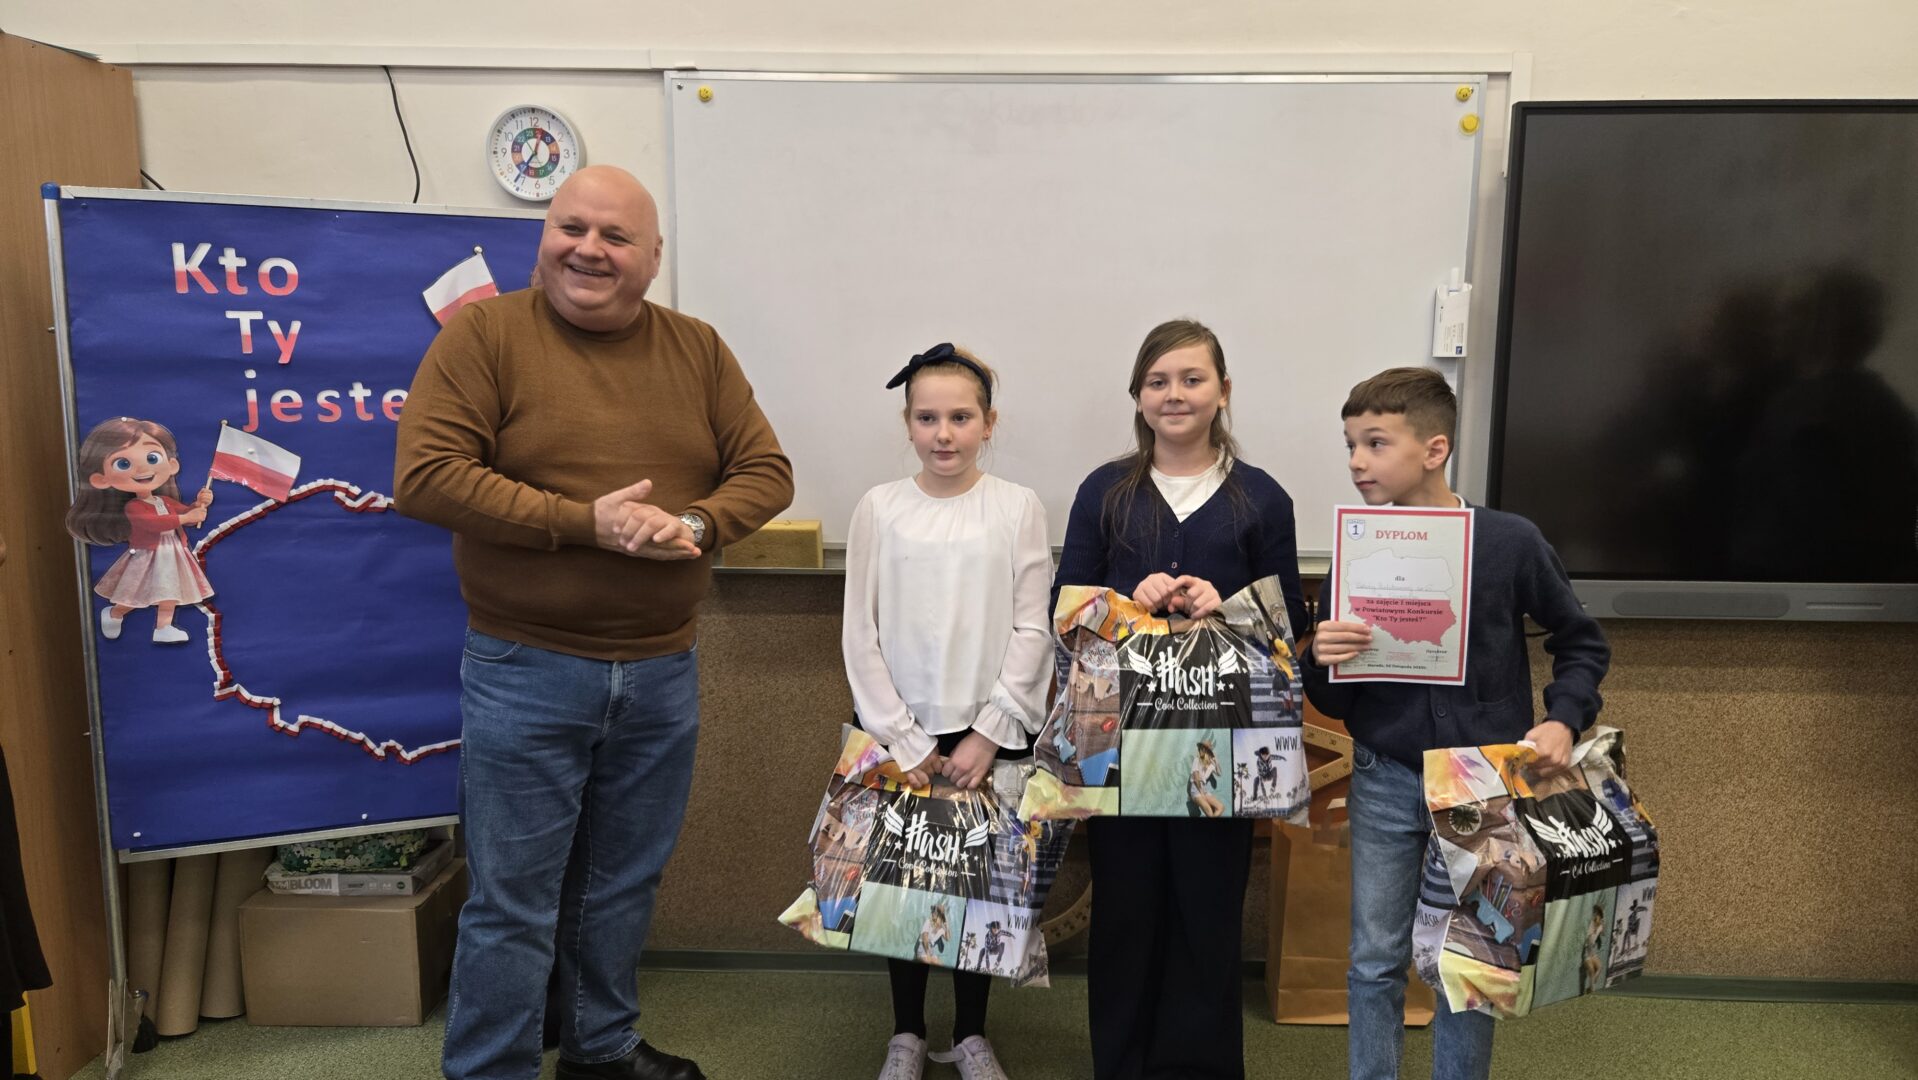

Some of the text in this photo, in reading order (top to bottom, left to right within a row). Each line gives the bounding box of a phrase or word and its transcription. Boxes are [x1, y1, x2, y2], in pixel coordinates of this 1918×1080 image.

[515, 120, 523, 130] 11
[529, 117, 539, 127] 12
[547, 120, 551, 130] 1
[504, 132, 514, 142] 10
[558, 132, 564, 142] 2
[500, 148, 508, 158] 9
[564, 149, 570, 158] 3
[506, 163, 514, 173] 8
[560, 166, 566, 175] 4
[520, 176, 526, 186] 7
[534, 180, 540, 189] 6
[549, 176, 556, 185] 5
[171, 242, 299, 296] Kto
[225, 310, 302, 364] Ty
[1352, 524, 1360, 536] 1
[1375, 530, 1428, 540] DYPLOM
[1362, 606, 1406, 614] Powiatowym
[1154, 696, 1218, 710] Cool Collection
[290, 878, 332, 890] BLOOM
